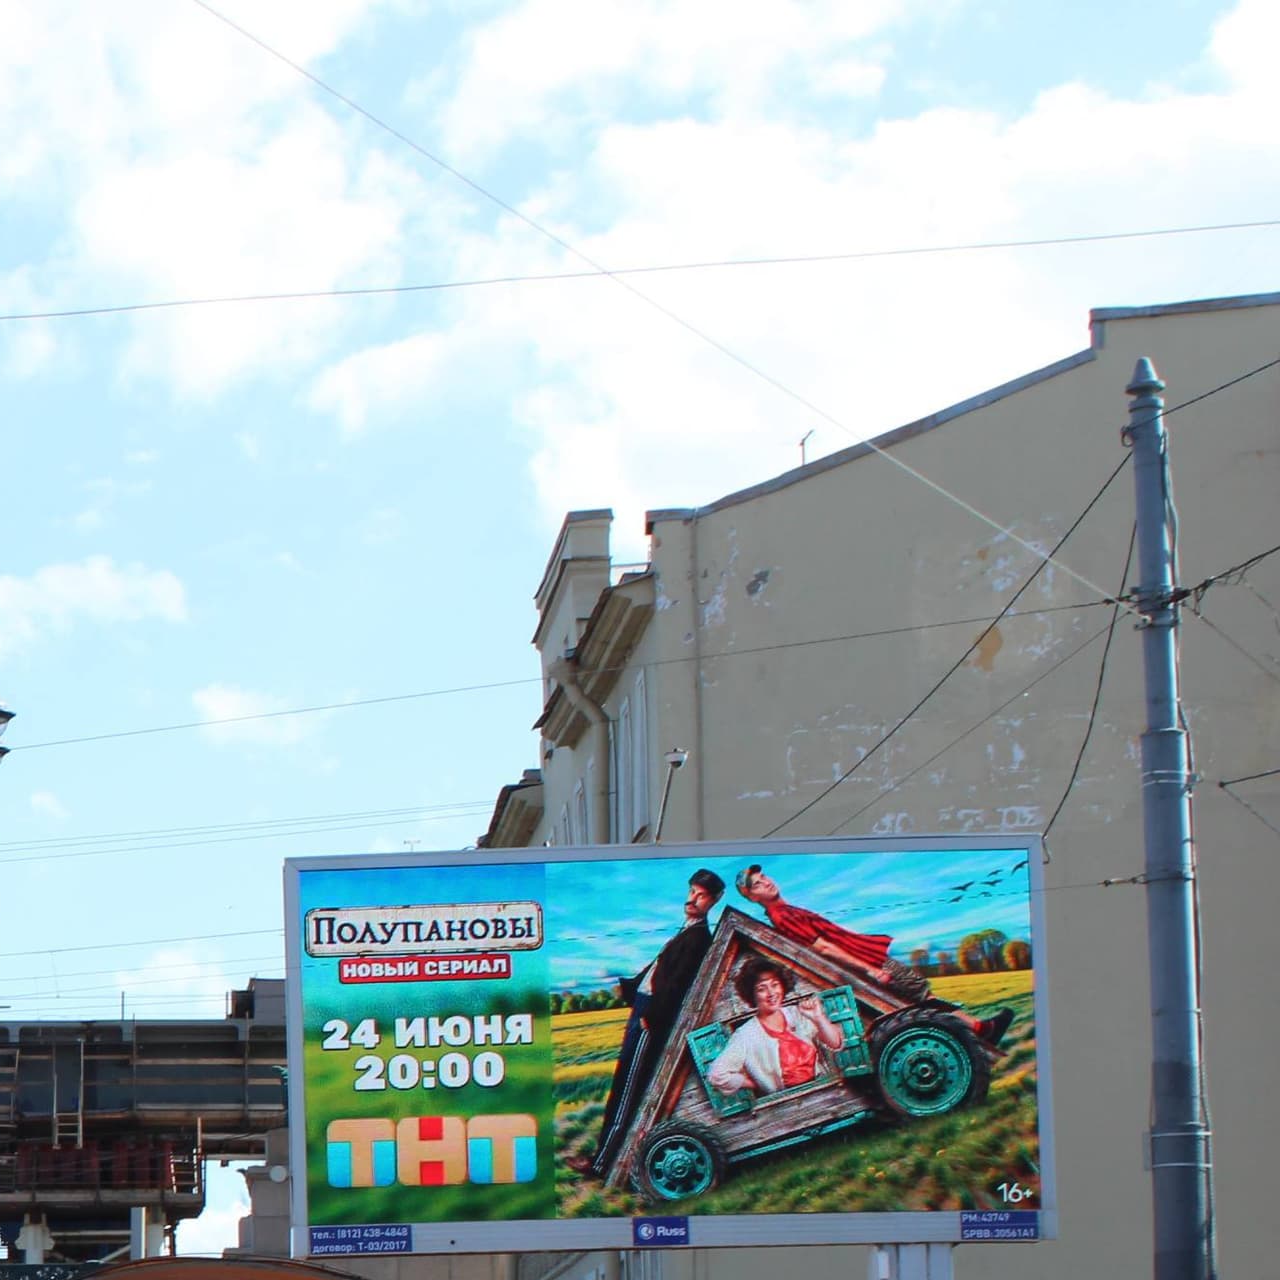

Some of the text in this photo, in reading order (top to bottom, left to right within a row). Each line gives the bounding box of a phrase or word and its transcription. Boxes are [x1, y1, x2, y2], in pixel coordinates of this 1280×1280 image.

[343, 957, 508, 978] НОВЫЙ СЕРИАЛ
[321, 1013, 534, 1050] 24 ИЮНЯ
[353, 1051, 506, 1091] 20:00
[327, 1113, 538, 1188] ТНТ
[997, 1182, 1034, 1203] 16+
[312, 1227, 409, 1239] тел.: (812) 438-4848
[656, 1226, 687, 1237] Russ
[312, 1243, 356, 1254] договор:
